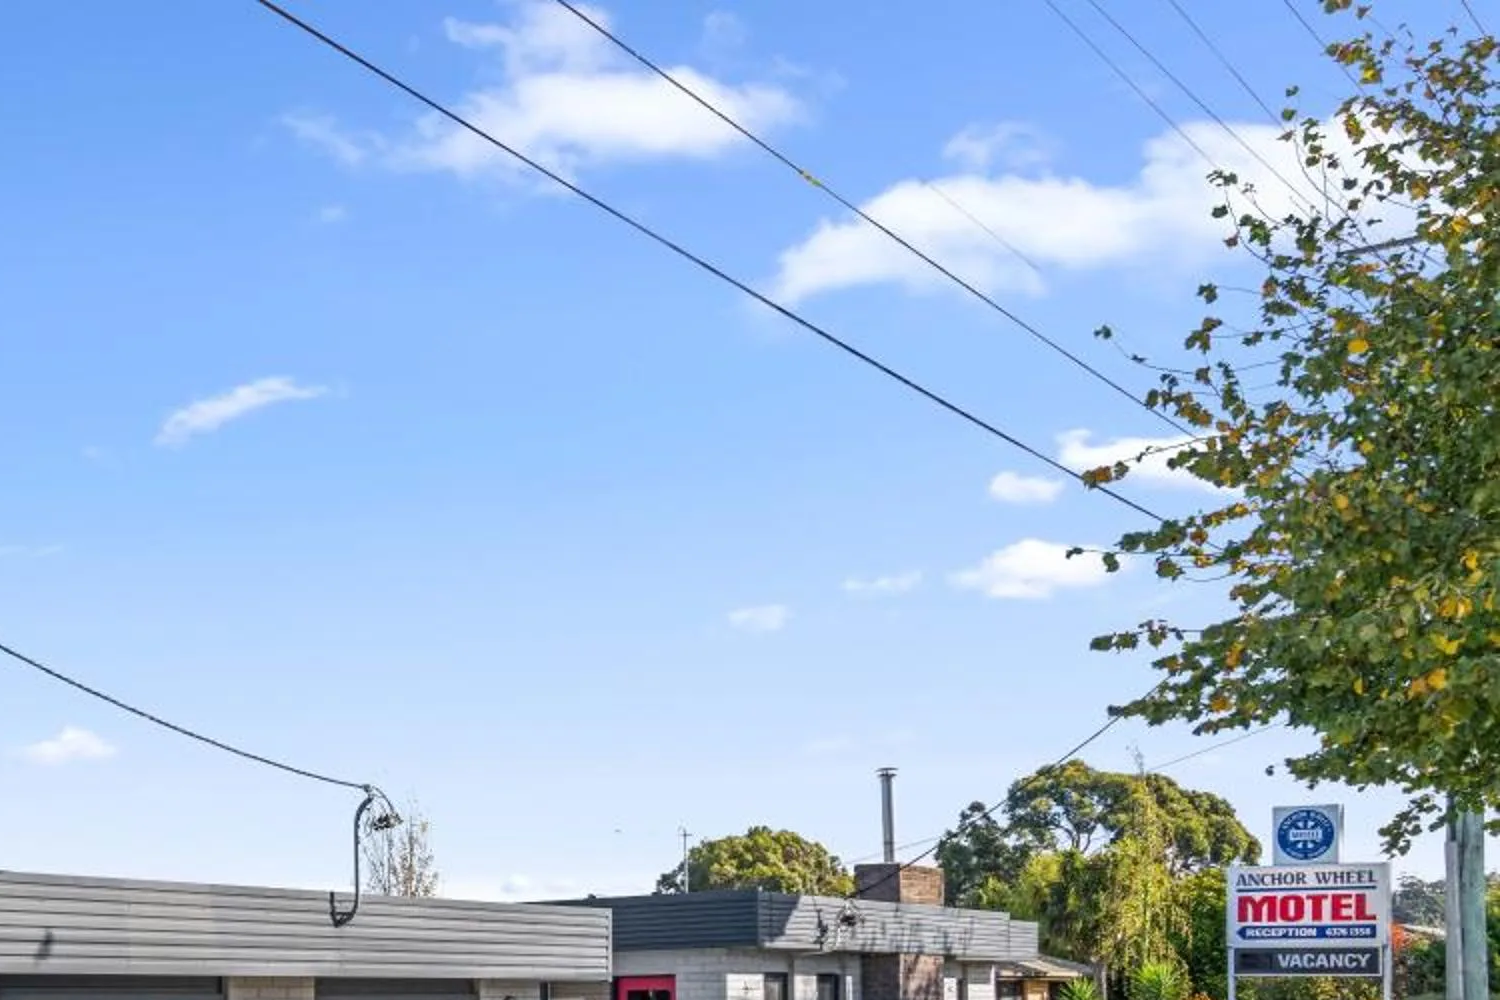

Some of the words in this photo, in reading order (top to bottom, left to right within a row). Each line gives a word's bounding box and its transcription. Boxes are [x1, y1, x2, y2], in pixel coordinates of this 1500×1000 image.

[1236, 871, 1307, 887] ANCHOR
[1315, 869, 1377, 885] WHEEL
[1237, 893, 1377, 922] MOTEL
[1246, 927, 1317, 937] RECEPTION
[1277, 953, 1372, 969] VACANCY
